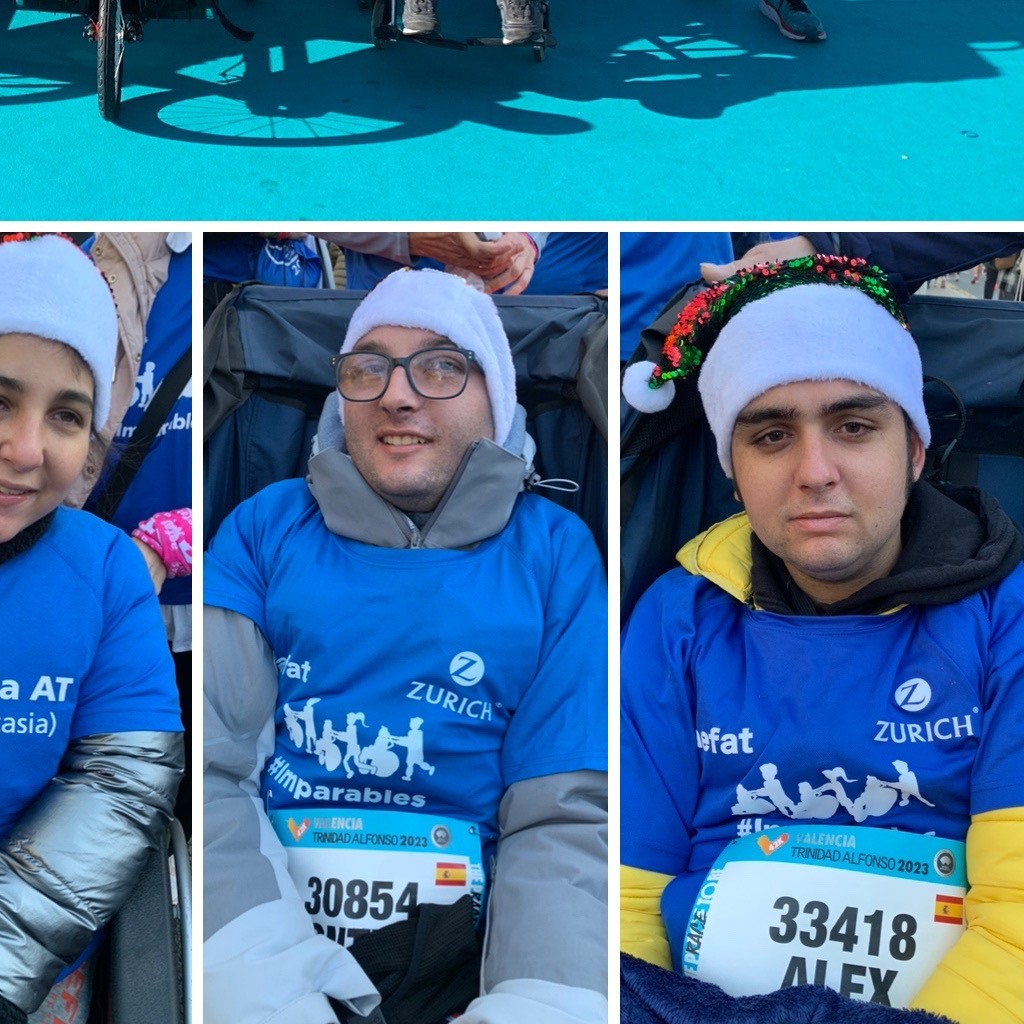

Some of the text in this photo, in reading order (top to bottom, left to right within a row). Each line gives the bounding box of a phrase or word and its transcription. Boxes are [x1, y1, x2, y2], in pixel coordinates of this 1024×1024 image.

[29, 676, 74, 703] AT
[405, 679, 493, 722] ZURICH
[873, 713, 975, 744] ZURICH
[267, 754, 426, 808] #Imparables
[312, 831, 428, 848] TRINIDAD ALFONSO 2023
[795, 831, 856, 849] VALENCIA
[790, 845, 929, 876] TRINIDAD ALFONSO 2023
[304, 876, 419, 921] 30854
[768, 895, 918, 962] 33418
